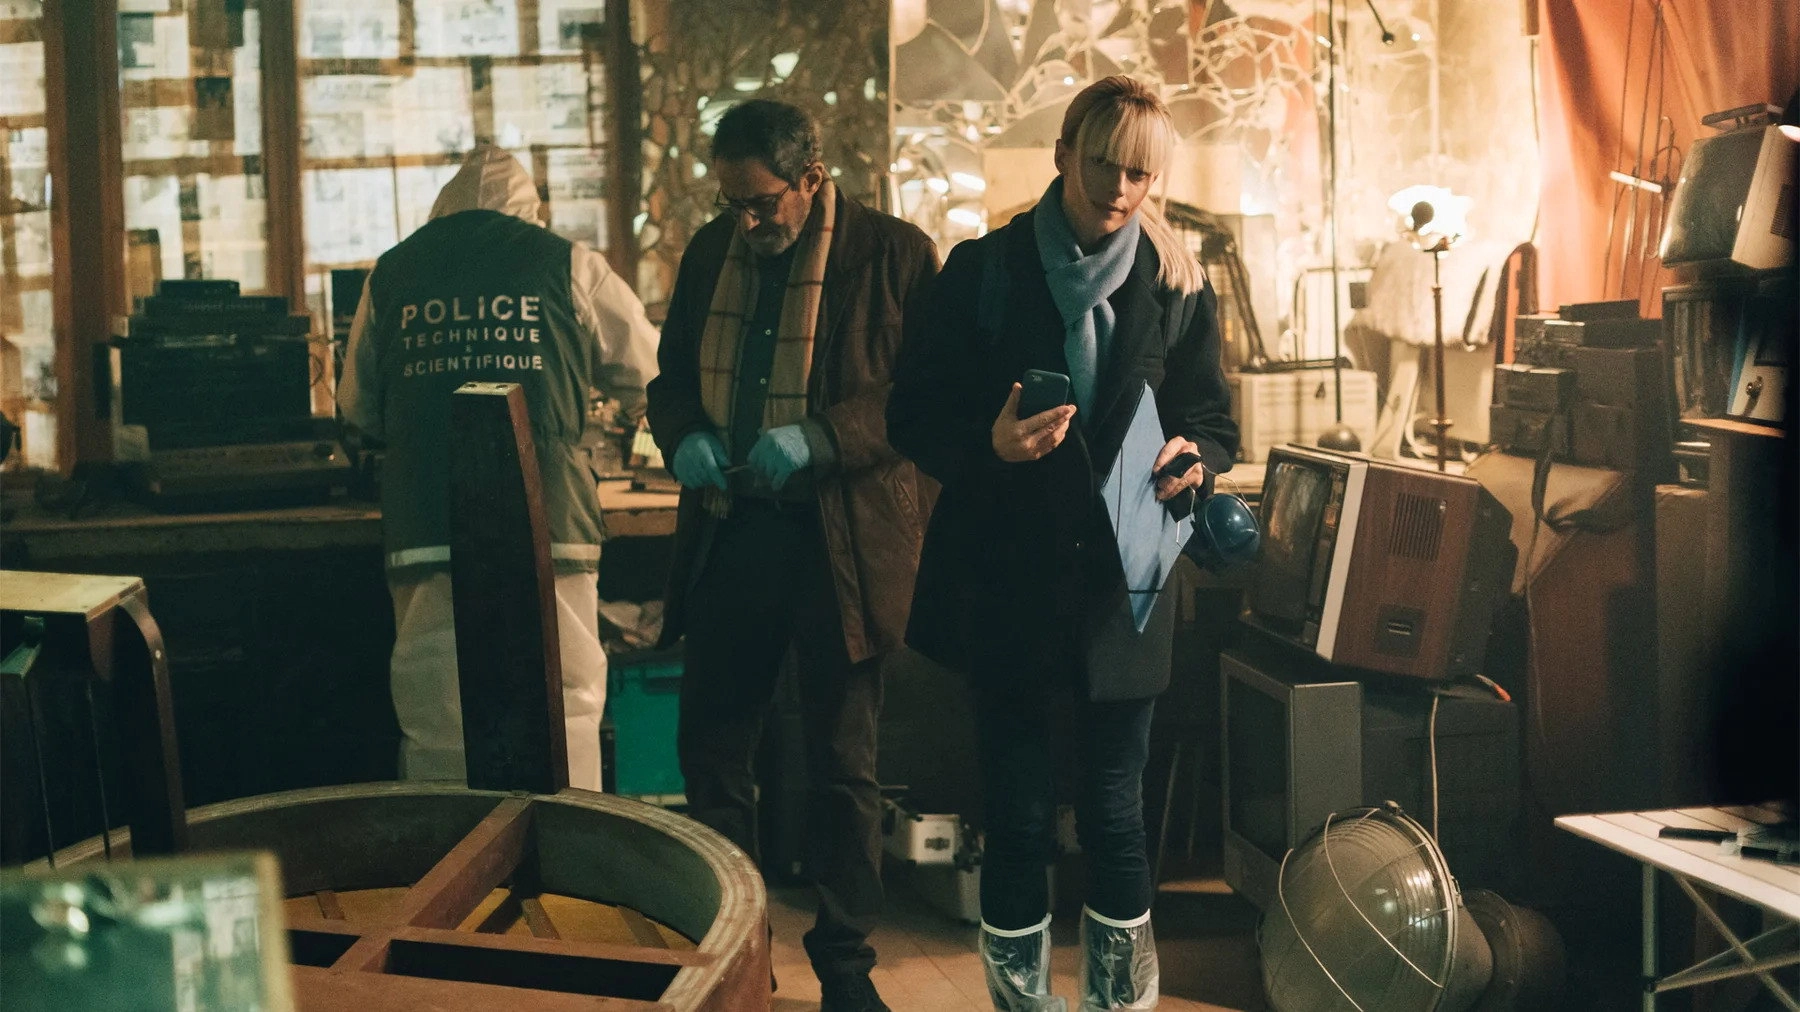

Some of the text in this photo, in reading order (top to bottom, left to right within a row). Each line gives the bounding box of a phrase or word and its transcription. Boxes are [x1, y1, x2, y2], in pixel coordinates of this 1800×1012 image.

[401, 295, 540, 329] POLICE
[403, 327, 541, 350] TECHNIQUE
[403, 354, 543, 377] SCIENTIFIQUE
